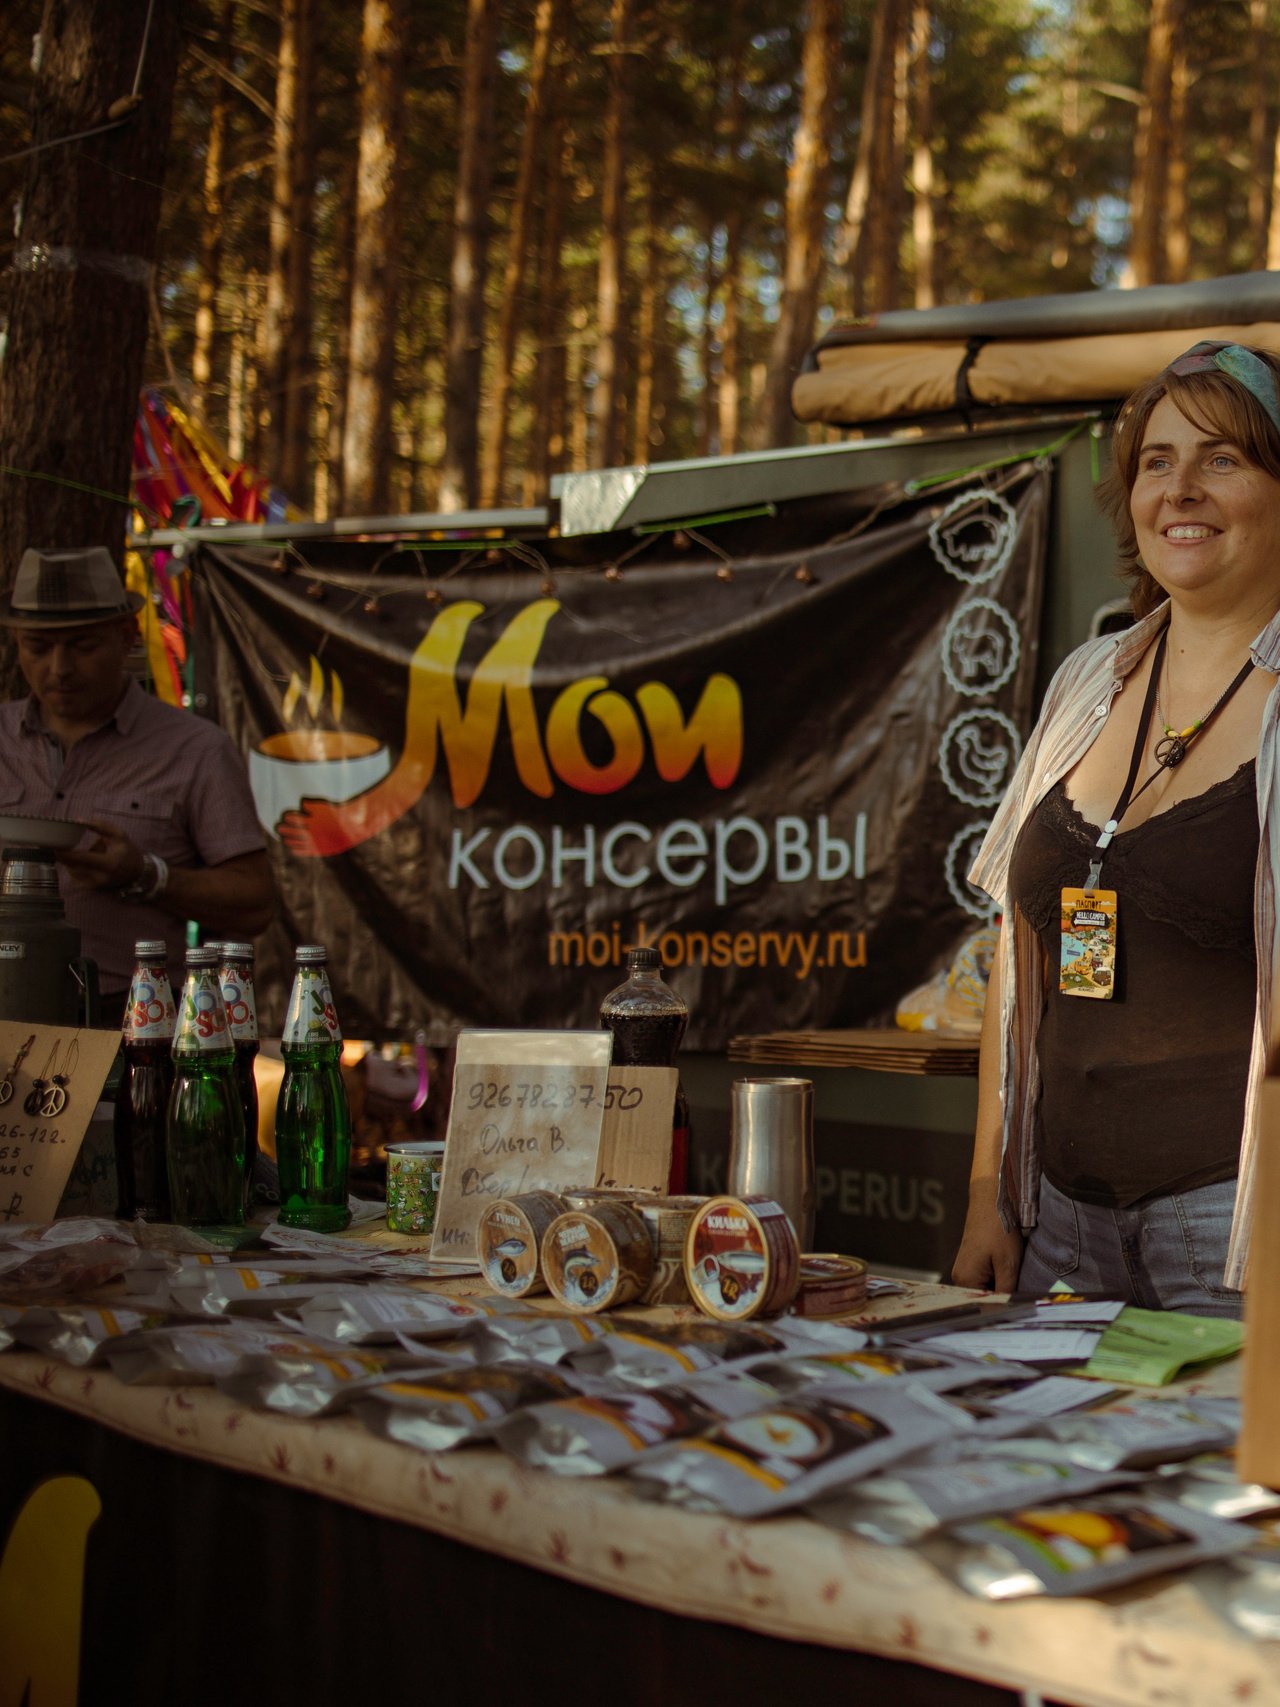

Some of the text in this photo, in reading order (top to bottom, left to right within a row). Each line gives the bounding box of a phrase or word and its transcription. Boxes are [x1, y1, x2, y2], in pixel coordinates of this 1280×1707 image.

[400, 598, 744, 809] Мои
[447, 811, 868, 906] консервы
[548, 920, 868, 980] moi-konservy.ru
[479, 1123, 540, 1156] Ольга
[697, 1152, 947, 1228] KPERUS
